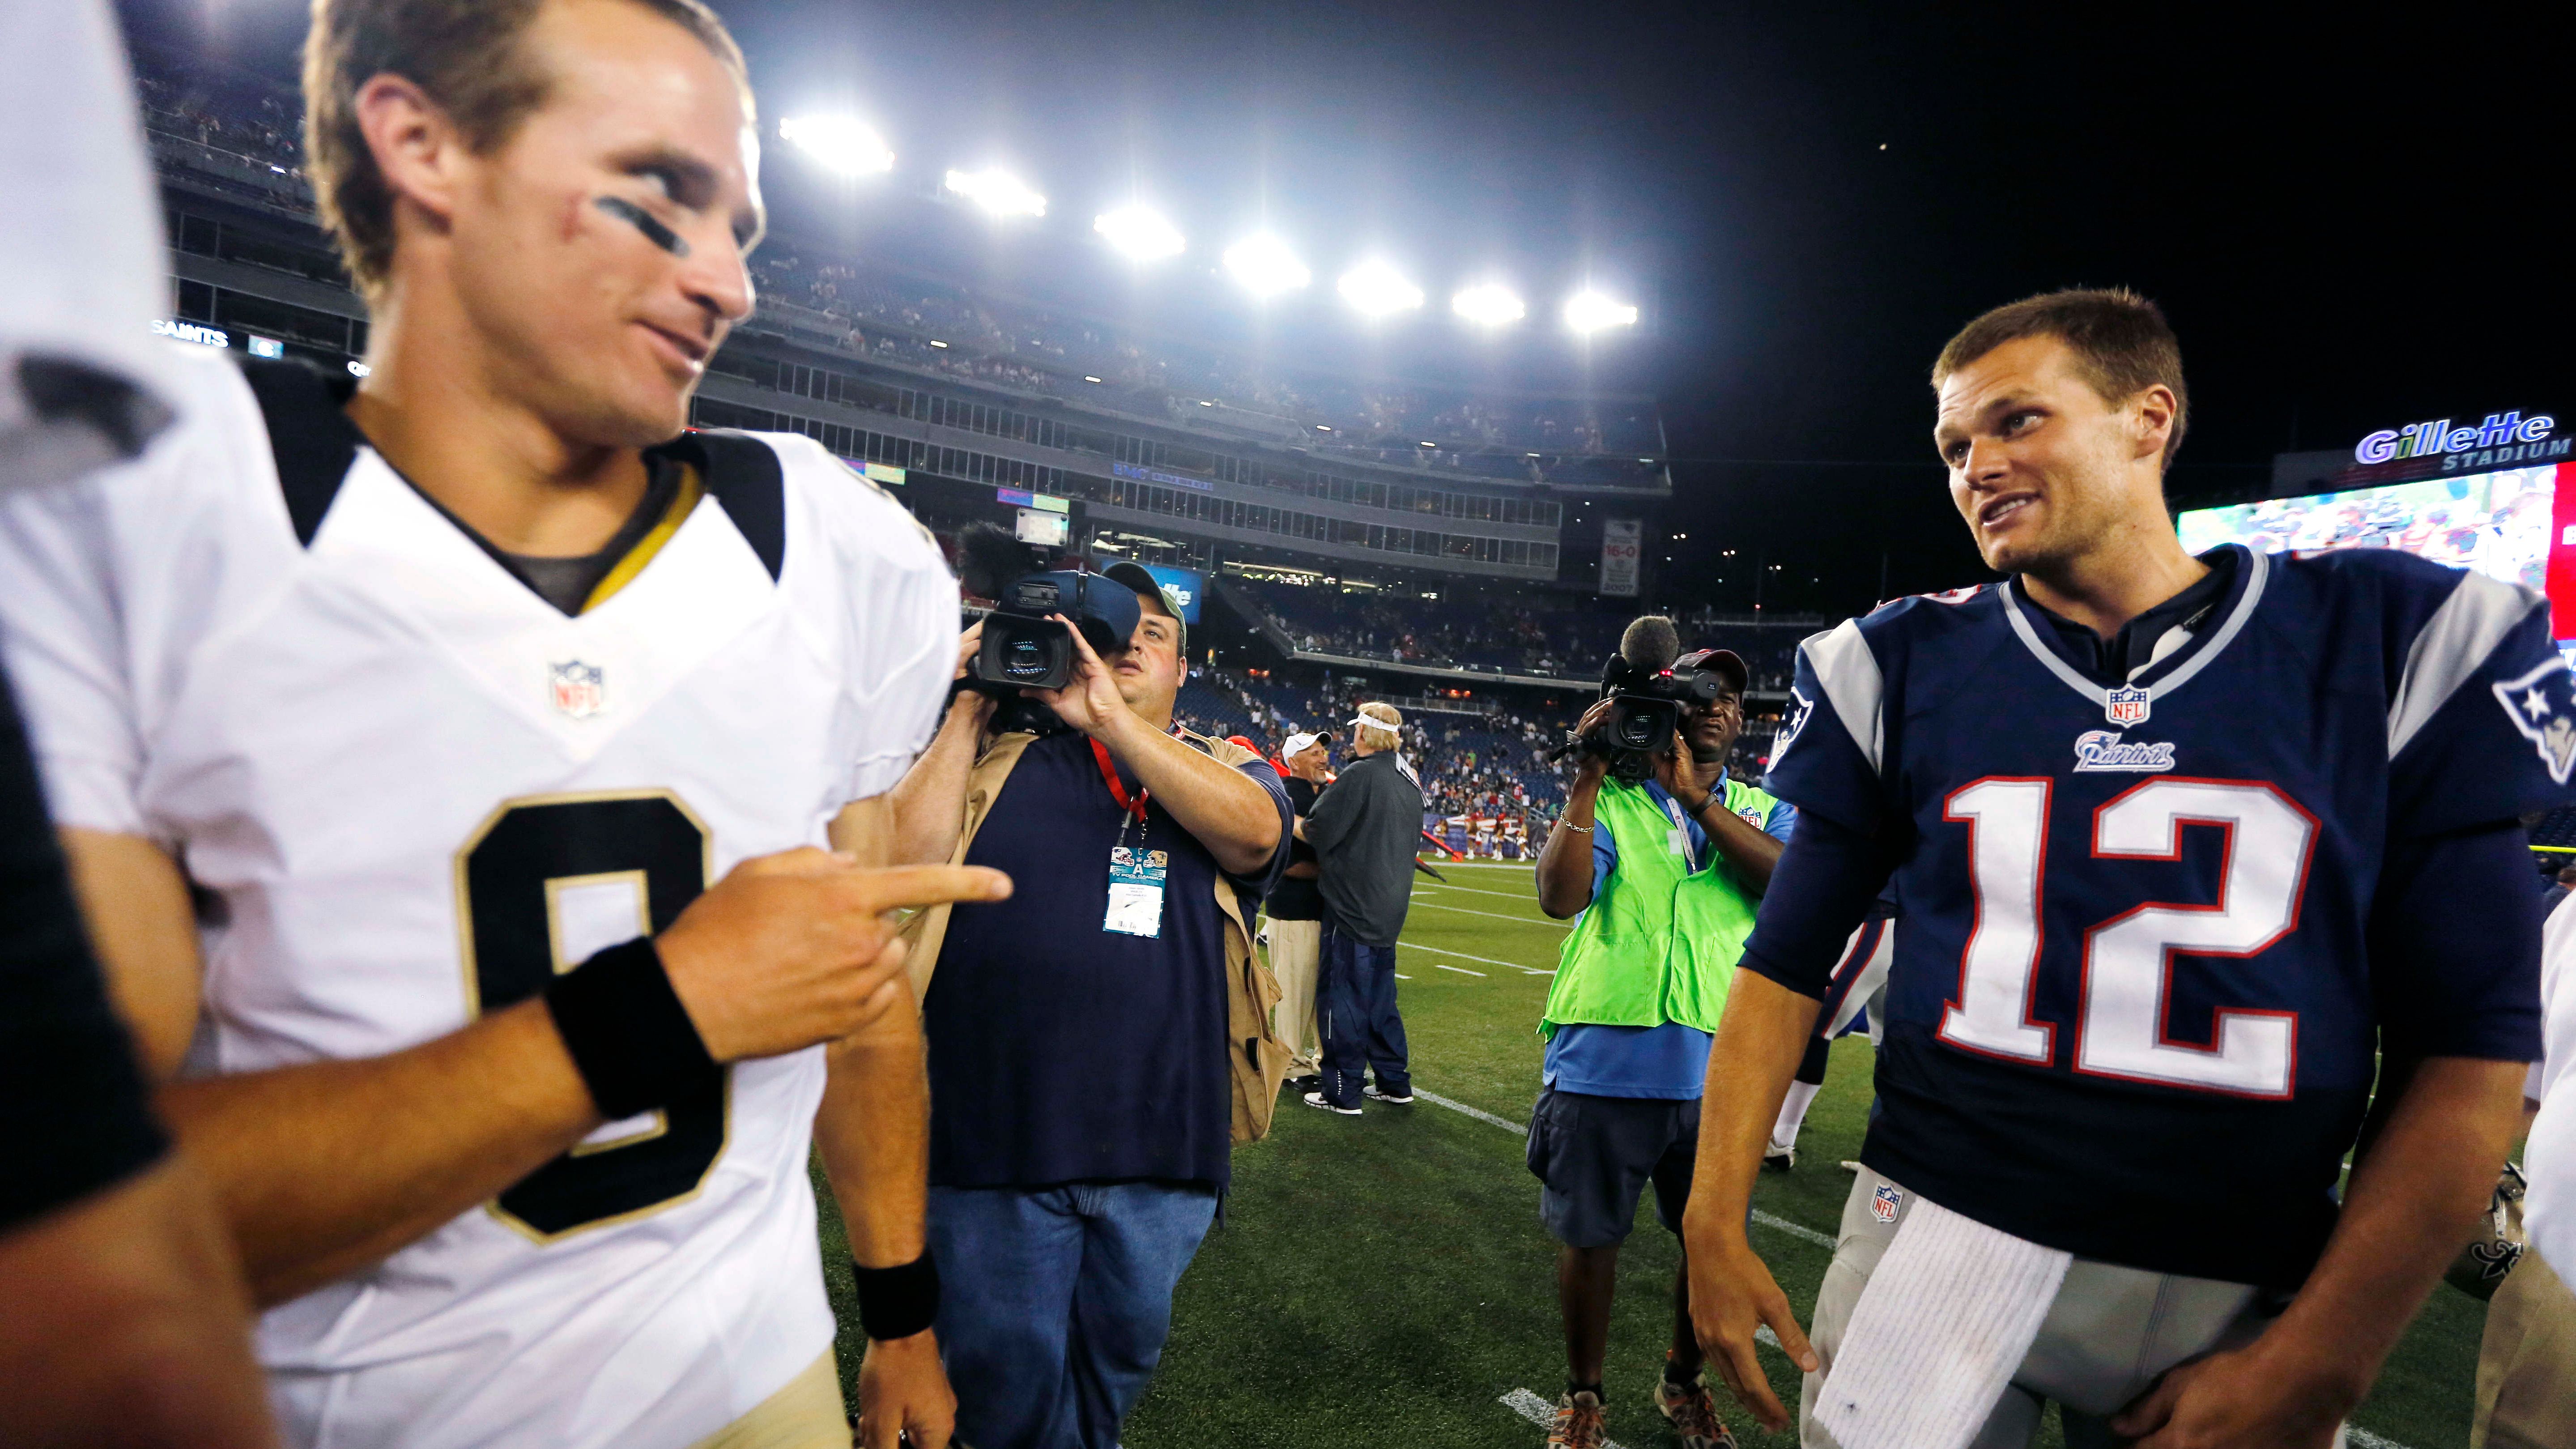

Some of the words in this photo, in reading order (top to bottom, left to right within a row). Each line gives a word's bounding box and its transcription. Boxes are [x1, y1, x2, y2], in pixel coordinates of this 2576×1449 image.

[151, 319, 229, 348] SAINTS
[2355, 410, 2555, 465] Gillette
[2441, 438, 2572, 471] STADIUM
[555, 684, 600, 710] NFL
[2112, 703, 2142, 719] NFL
[2074, 738, 2175, 771] Patriots
[1133, 864, 1144, 874] A
[1935, 775, 2322, 1100] 12
[1874, 1198, 1893, 1218] NFL
